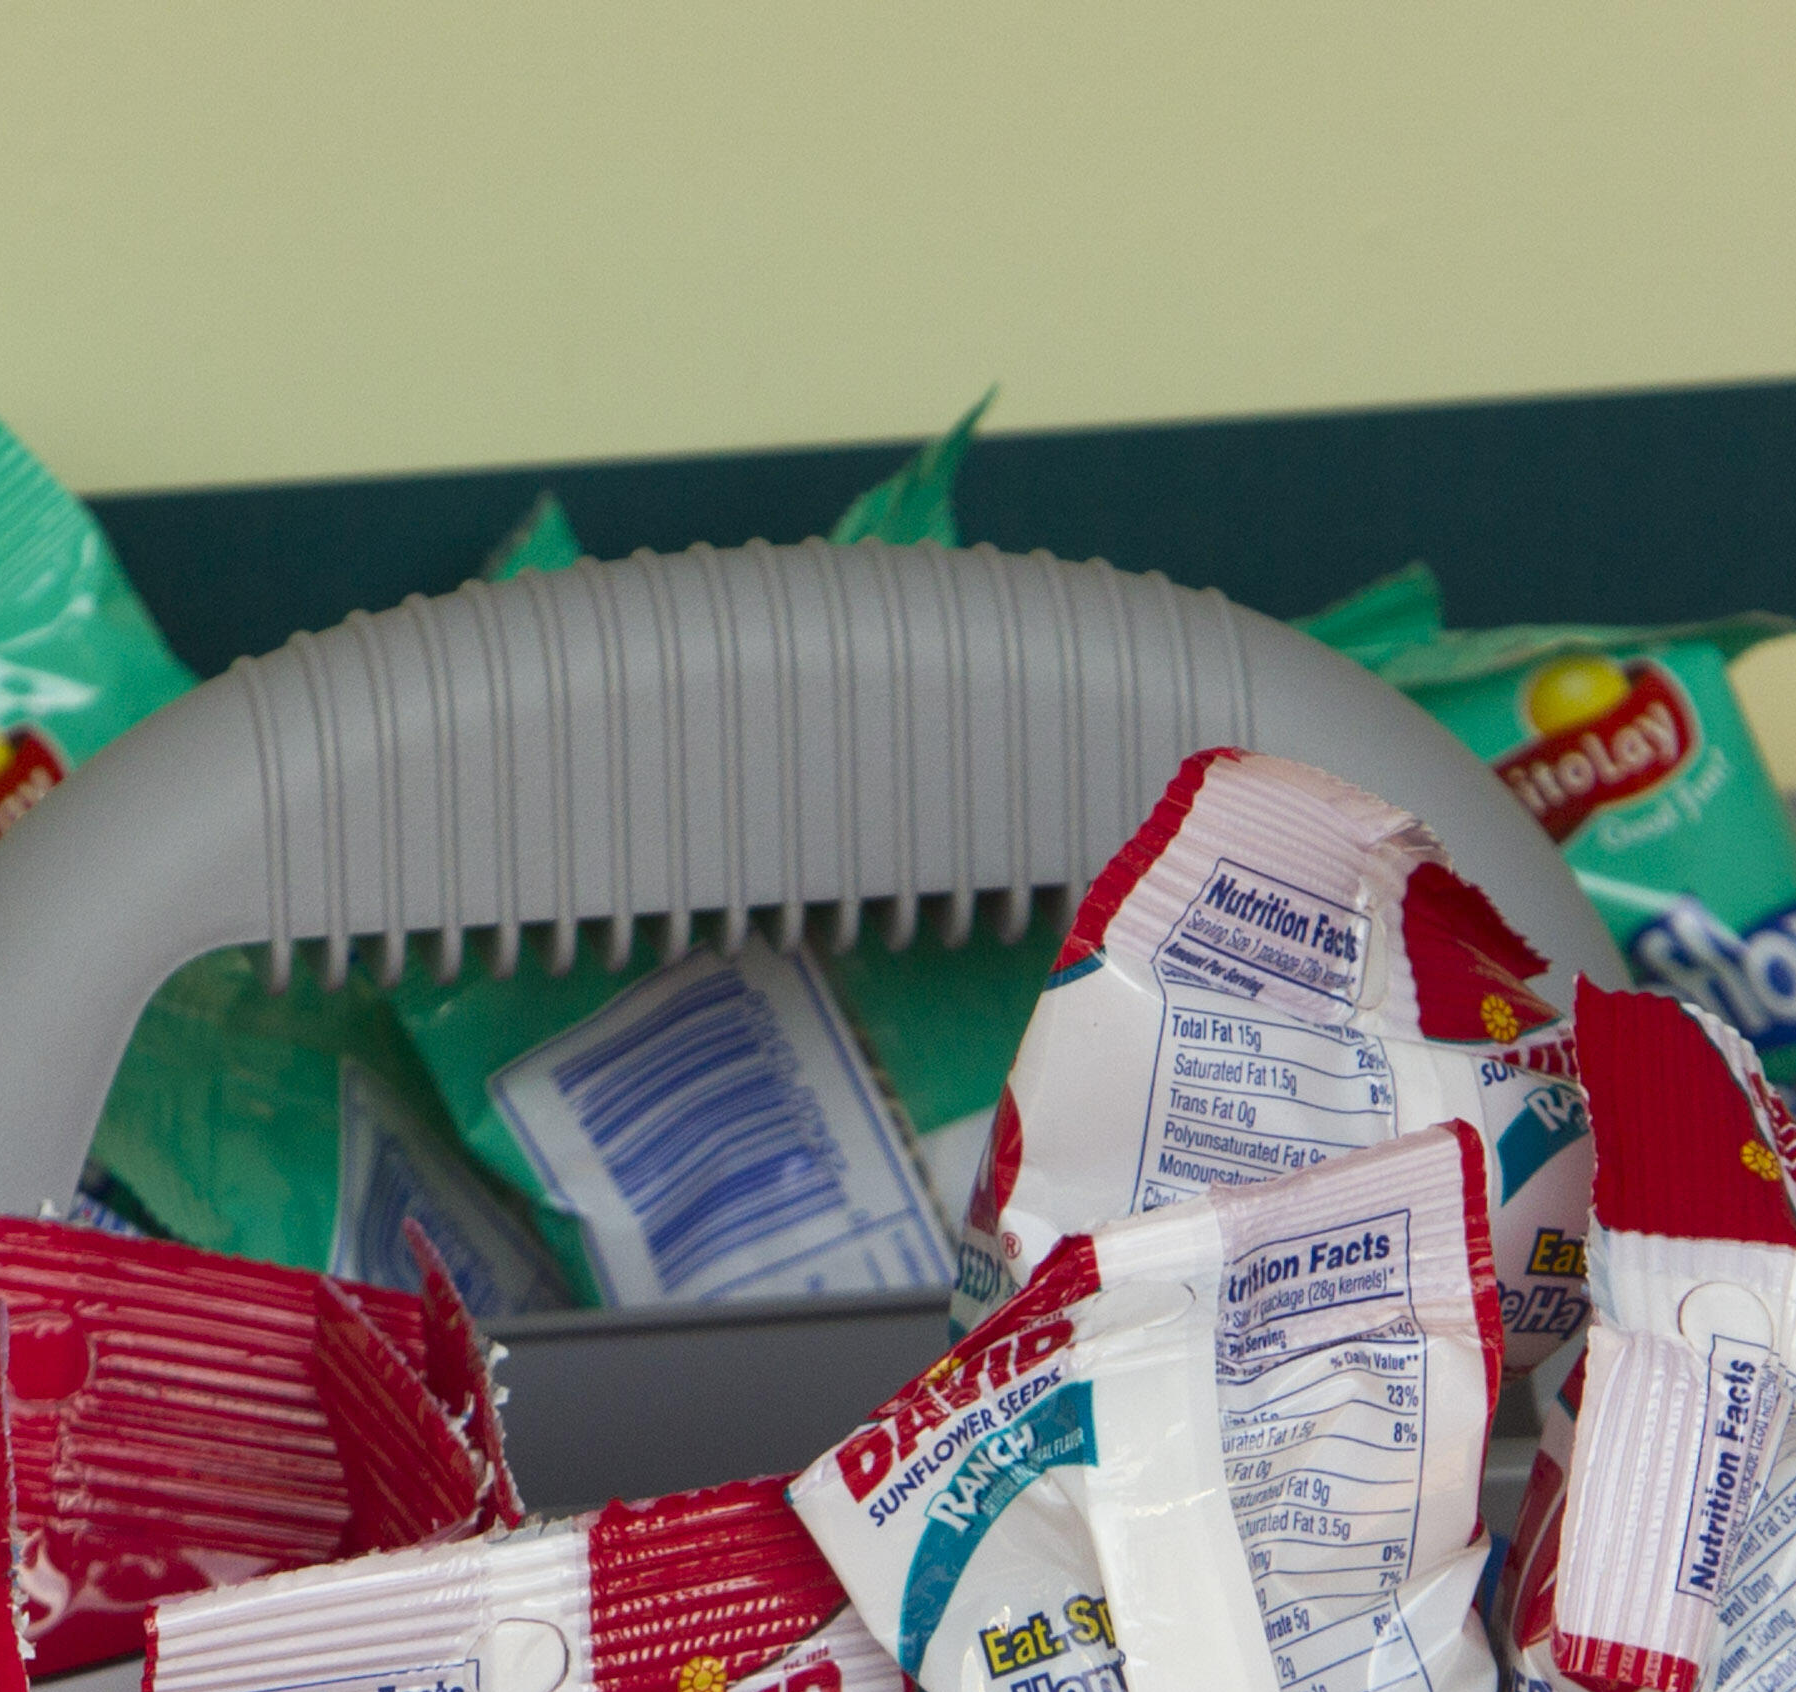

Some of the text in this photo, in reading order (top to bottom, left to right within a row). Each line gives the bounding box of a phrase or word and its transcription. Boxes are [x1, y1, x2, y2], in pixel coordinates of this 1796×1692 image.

[1203, 874, 1358, 964] Nutrition Facts
[1172, 1014, 1261, 1053] Total Fat 15g
[1173, 1053, 1298, 1097] Saturated Fat 1.5g
[1170, 1087, 1257, 1128] Trans Fat 0g
[1369, 1083, 1393, 1106] 8%
[1163, 1120, 1306, 1168] Polyunsaturated Fat
[1309, 1232, 1391, 1274] Facts
[1308, 1279, 1336, 1305] (28g
[1344, 1351, 1372, 1370] Daily
[1386, 1383, 1419, 1408] 23%
[1714, 1359, 1757, 1444] Facts
[868, 1408, 998, 1527] SUNFLOWER
[997, 1366, 1063, 1422] SEEDS
[1268, 1426, 1288, 1447] Fat
[1393, 1421, 1418, 1444] 8%
[924, 1422, 1039, 1533] RANCH
[1233, 1462, 1254, 1481] Fat
[1286, 1476, 1331, 1507] Fat 9g
[1293, 1511, 1314, 1538] Fat
[1318, 1515, 1352, 1541] 3.5g
[1688, 1451, 1742, 1592] Nutrition
[1382, 1544, 1406, 1562] 0%
[1379, 1570, 1402, 1588] 7%
[1293, 1606, 1310, 1632] 5g
[978, 1610, 1070, 1680] Eat.
[1277, 1654, 1296, 1681] 2g
